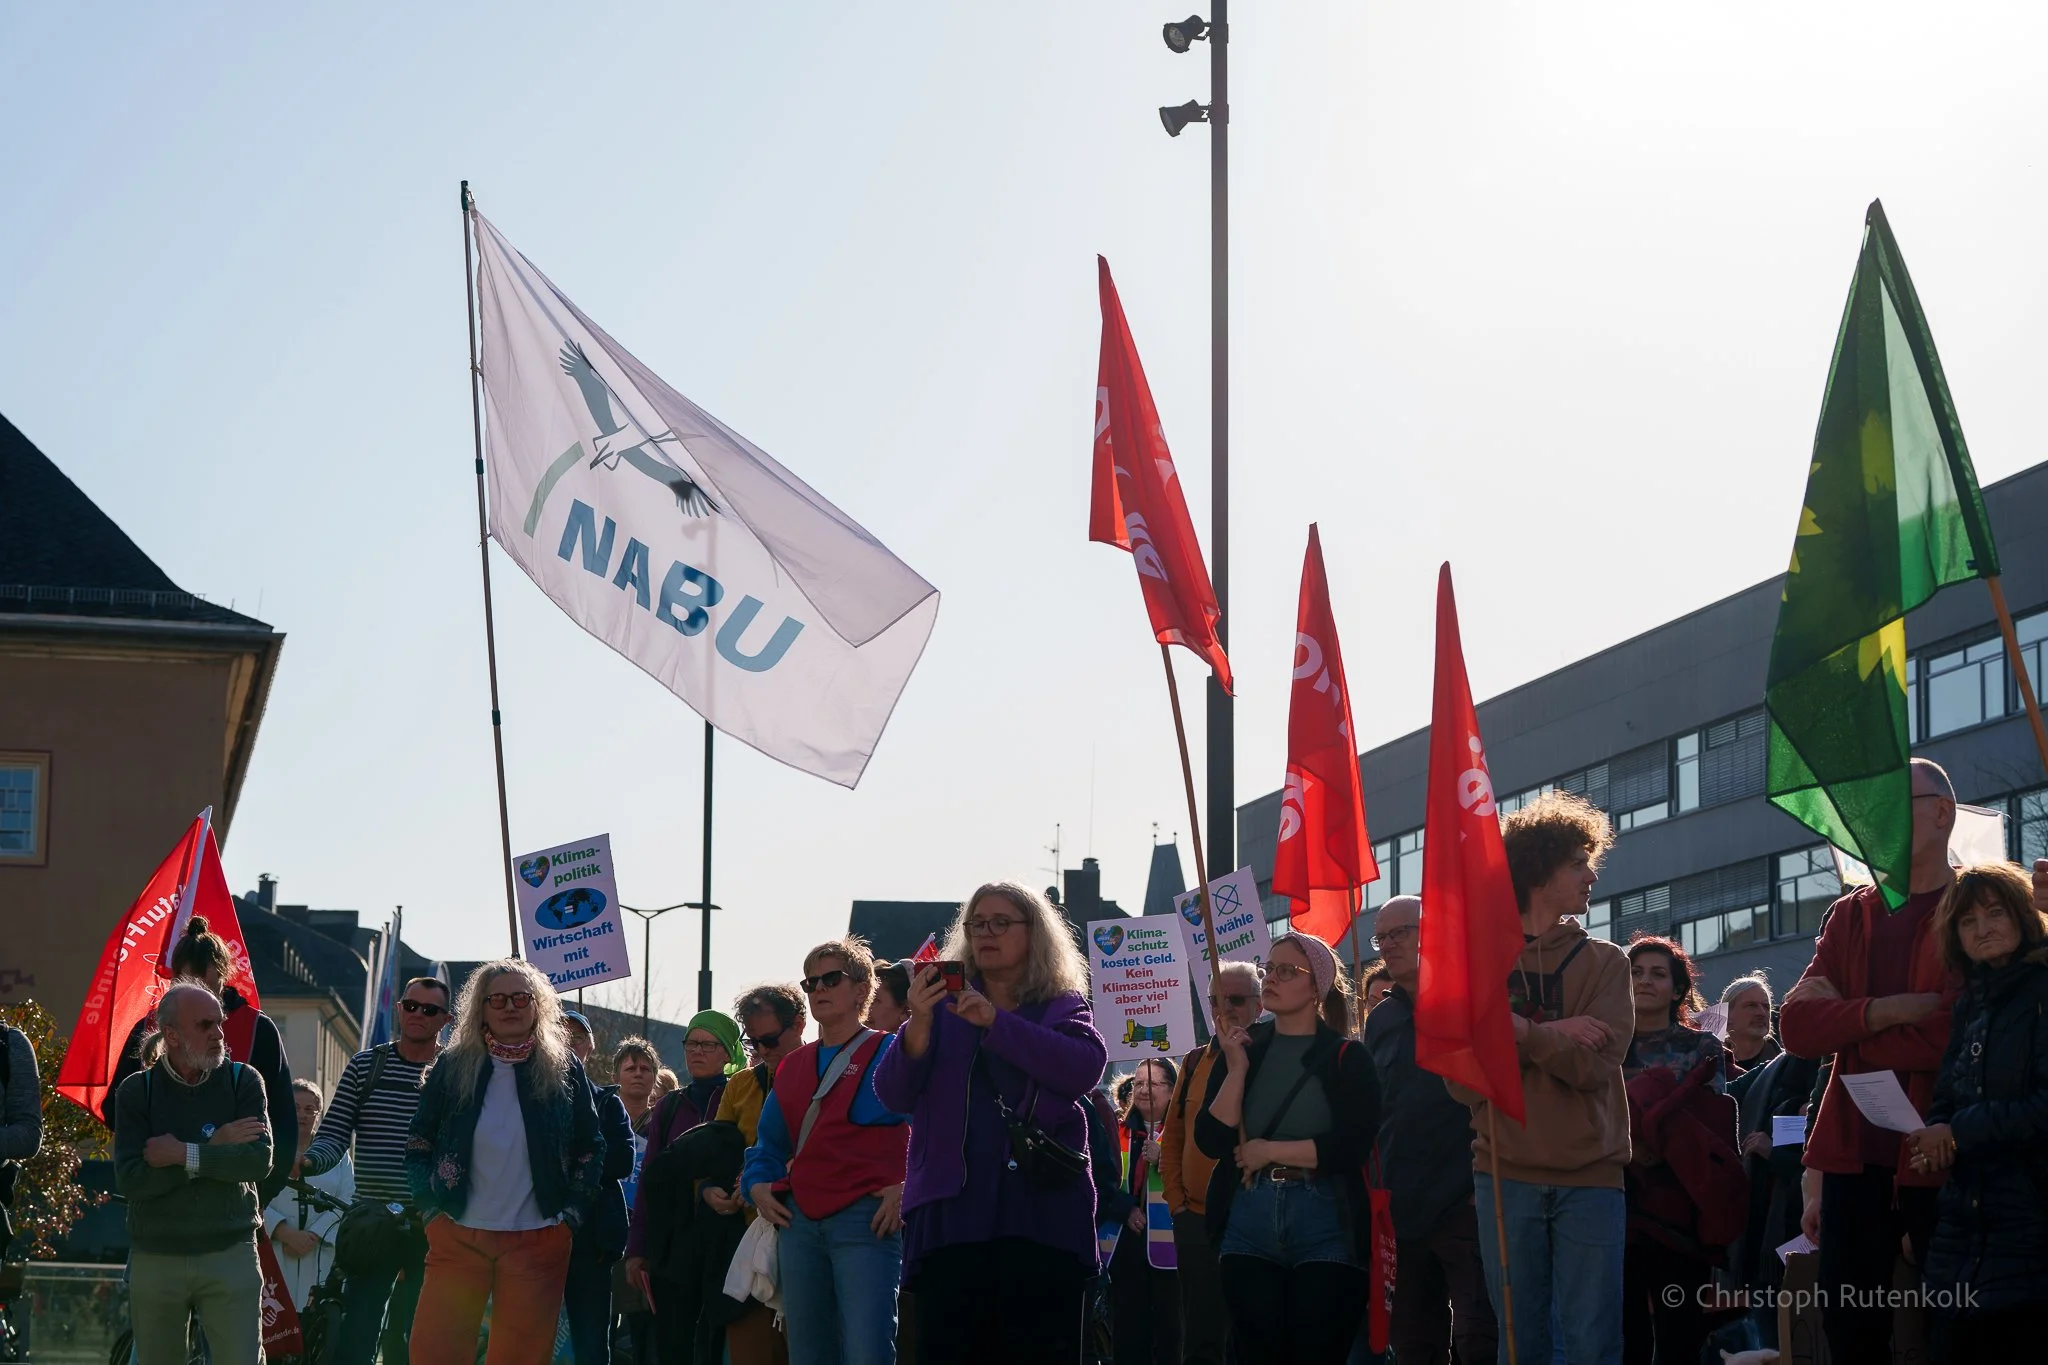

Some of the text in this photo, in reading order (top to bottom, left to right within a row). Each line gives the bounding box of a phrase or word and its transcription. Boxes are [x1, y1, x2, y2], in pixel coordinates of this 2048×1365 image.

[557, 498, 806, 673] NABU
[551, 847, 601, 867] Klima-
[553, 863, 602, 888] politik
[1215, 912, 1254, 936] wähle
[532, 920, 614, 951] Wirtschaft
[1126, 929, 1167, 940] Klima-
[1127, 940, 1169, 953] schutz
[1201, 930, 1256, 962] Zkunft!
[563, 946, 590, 963] mit
[1101, 953, 1176, 969] kostet Geld.
[1125, 968, 1154, 979] Kein
[1102, 978, 1180, 994] Klimaschutz
[1114, 991, 1169, 1005] aber viel
[1124, 1004, 1161, 1016] mehr!
